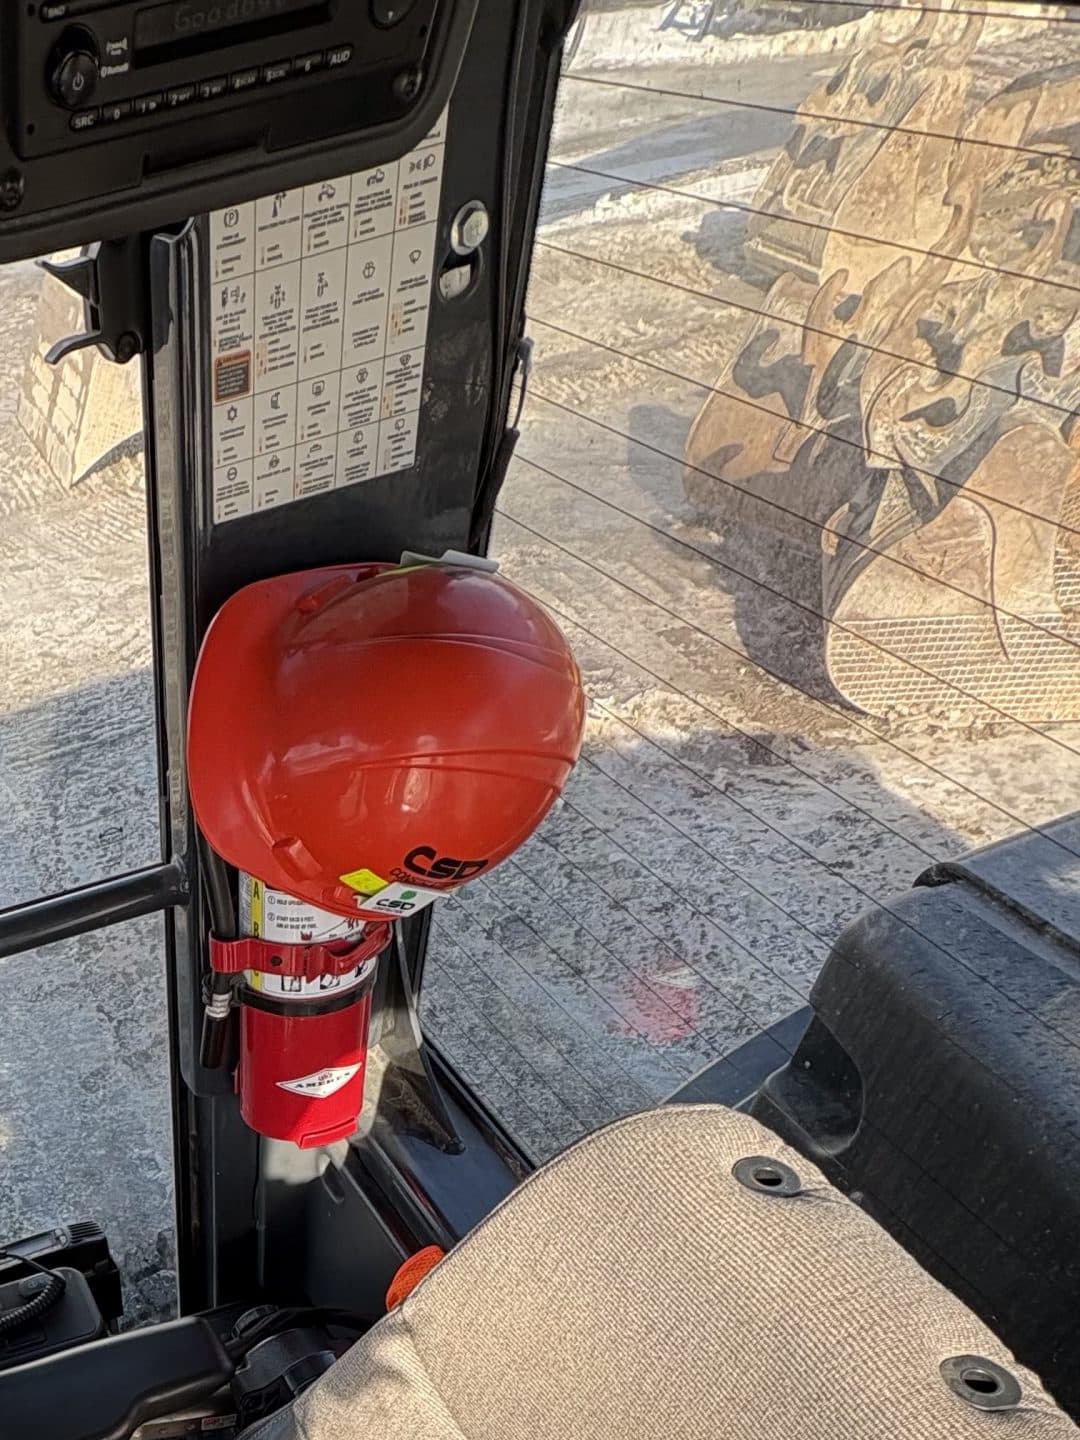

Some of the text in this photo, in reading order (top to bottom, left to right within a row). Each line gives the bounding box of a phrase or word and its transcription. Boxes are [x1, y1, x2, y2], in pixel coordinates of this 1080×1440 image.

[330, 51, 351, 64] AUD
[75, 115, 94, 127] SRC
[404, 845, 489, 880] CSD
[253, 881, 260, 900] A
[376, 898, 416, 911] CSD
